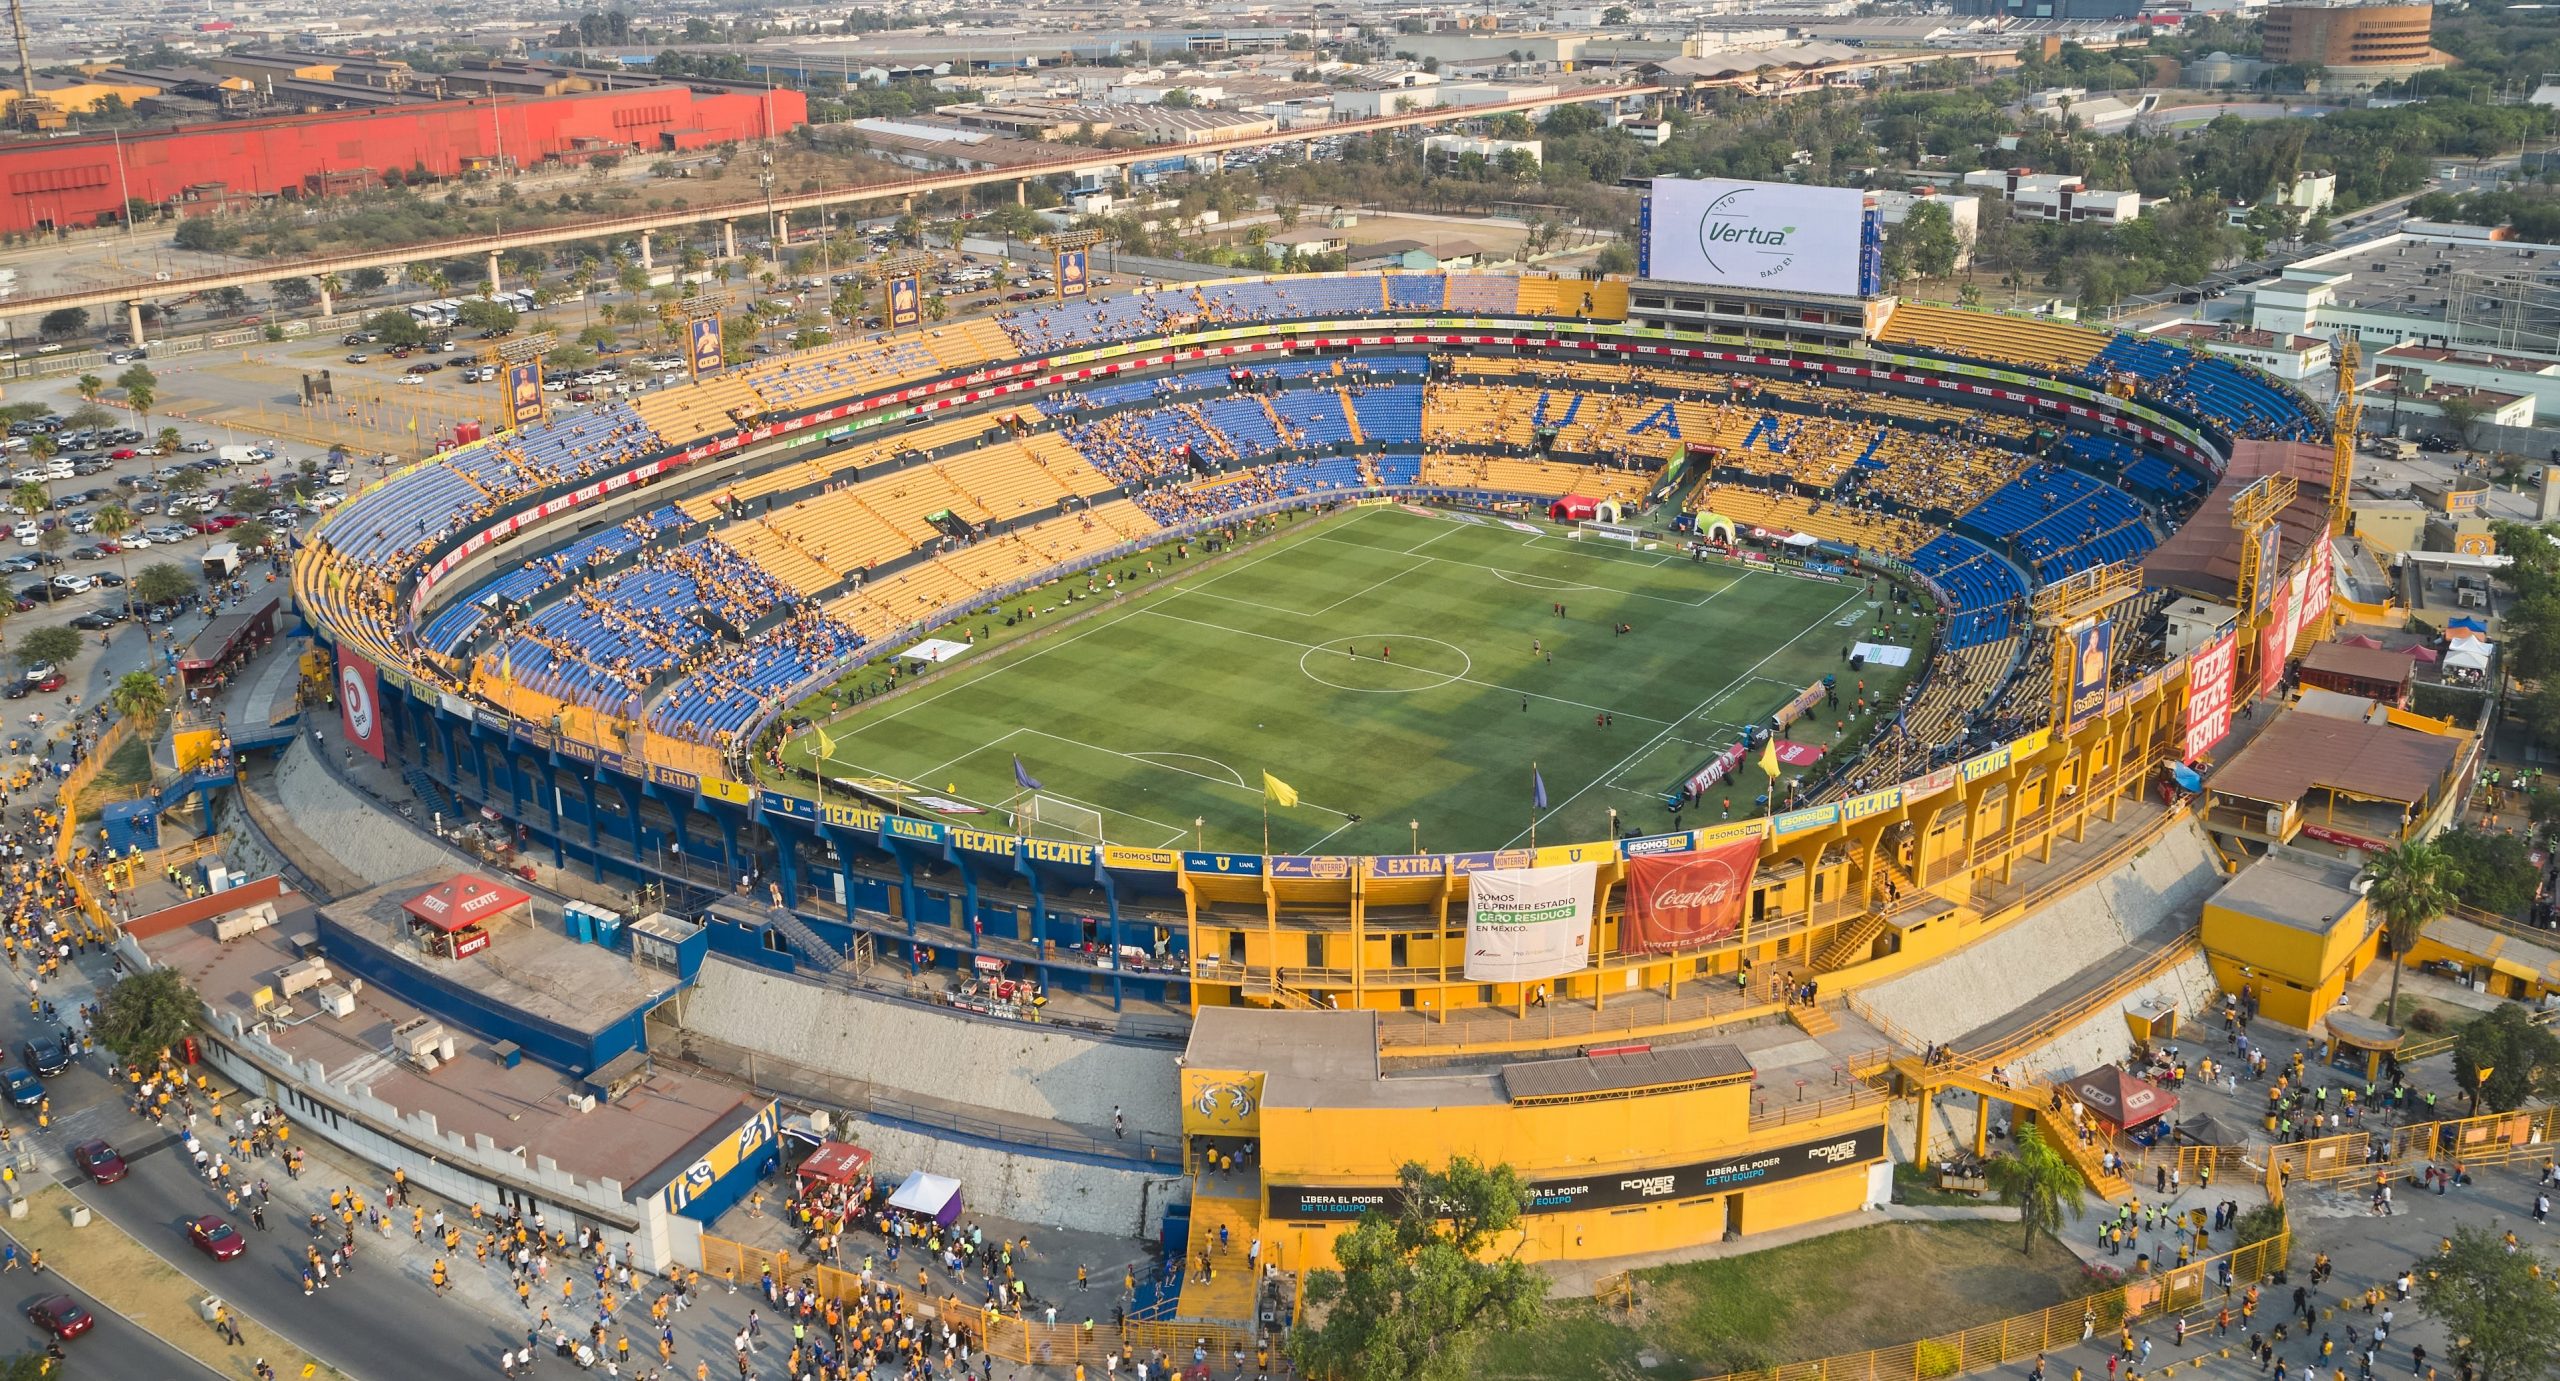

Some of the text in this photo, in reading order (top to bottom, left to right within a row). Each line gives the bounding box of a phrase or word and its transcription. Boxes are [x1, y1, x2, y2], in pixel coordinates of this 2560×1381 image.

[1709, 222, 1785, 245] Vertua
[1760, 265, 1784, 278] BAJO
[1280, 325, 1296, 333] EXTRA
[1636, 329, 1652, 337] EXTRA
[1297, 339, 1315, 347] TECATE
[1329, 338, 1348, 346] TECATE
[1427, 335, 1447, 343] TECATE
[1494, 337, 1513, 345] TECATE
[1526, 338, 1546, 346] TECATE
[1559, 340, 1579, 348] TECATE
[1714, 335, 1733, 344] EXTRA
[1753, 339, 1773, 347] EXTRA
[1265, 342, 1283, 350] TECATE
[1597, 342, 1617, 351] TECATE
[1637, 345, 1657, 354] TECATE
[1793, 343, 1813, 352] EXTRA
[1670, 348, 1690, 357] TECATE
[1703, 351, 1723, 360] TECATE
[1736, 354, 1756, 363] TECATE
[1834, 348, 1854, 357] EXTRA
[1769, 358, 1789, 367] TECATE
[1803, 362, 1823, 371] TECATE
[1916, 359, 1935, 367] EXTRA
[1837, 366, 1857, 375] TECATE
[1870, 370, 1891, 380] TECATE
[1904, 375, 1925, 385] TECATE
[1938, 380, 1959, 390] TECATE
[2038, 379, 2055, 389] EXTRA
[978, 388, 995, 399] TECATE
[1972, 386, 1992, 396] TECATE
[2006, 392, 2026, 402] TECATE
[2039, 398, 2058, 409] TECATE
[895, 406, 916, 418] AFIRME
[2070, 405, 2088, 416] TECATE
[861, 415, 883, 427] AFIRME
[829, 424, 850, 437] AFIRME
[796, 434, 817, 446] AFIRME
[635, 463, 659, 480] TECATE
[605, 475, 630, 491] TECATE
[576, 487, 600, 503] TECATE
[546, 499, 570, 515] TECATE
[516, 510, 540, 527] TECATE
[491, 524, 512, 540] TECATE
[2302, 580, 2328, 628] TECATE
[2167, 659, 2185, 678] EXTRA
[2192, 636, 2234, 690] TECATE
[411, 680, 440, 706] TECATE
[2189, 671, 2229, 725] TECATE
[2186, 704, 2228, 760] TECATE
[2027, 738, 2035, 750] U
[563, 741, 595, 762] EXTRA
[1964, 747, 2009, 781] TECATE
[661, 769, 696, 790] EXTRA
[1699, 761, 1724, 791] TECATE
[719, 782, 731, 796] U
[782, 798, 794, 812] U
[1845, 788, 1900, 819] TECATE
[821, 801, 881, 831] TECATE
[891, 819, 938, 841] UANL
[2307, 826, 2331, 838] Coca-Cola
[950, 827, 1016, 857] TECATE
[1023, 838, 1092, 866] TECATE
[1568, 849, 1582, 863] U
[1216, 856, 1231, 871] U
[1239, 861, 1255, 869] UANL
[1311, 862, 1347, 873] MONTERREY
[1388, 856, 1443, 875] EXTRA
[1495, 856, 1529, 867] MONTERREY
[1477, 893, 1515, 902] SOMOS
[1655, 879, 1732, 910] Coca-Cola
[422, 894, 449, 914] TECATE
[461, 891, 500, 912] TECATE
[1477, 897, 1576, 911] EL PRIMER ESTADIO
[1479, 908, 1572, 922] CERO RESIDUOS
[460, 936, 486, 954] TECATE
[1808, 1140, 1857, 1159] POWER
[1827, 1149, 1856, 1163] ADE
[838, 1153, 859, 1172] TECATE
[1706, 1157, 1780, 1177] LIBERA EL PODER
[1621, 1175, 1675, 1191] POWER
[1706, 1168, 1765, 1186] DE TU EQUIPO
[1544, 1186, 1588, 1196] EL PODER
[1642, 1185, 1675, 1196] ADE
[1301, 1195, 1383, 1204] LIBERA EL PODER
[1537, 1196, 1571, 1206] EQUIPO
[1301, 1204, 1366, 1213] DE TU EQUIPO
